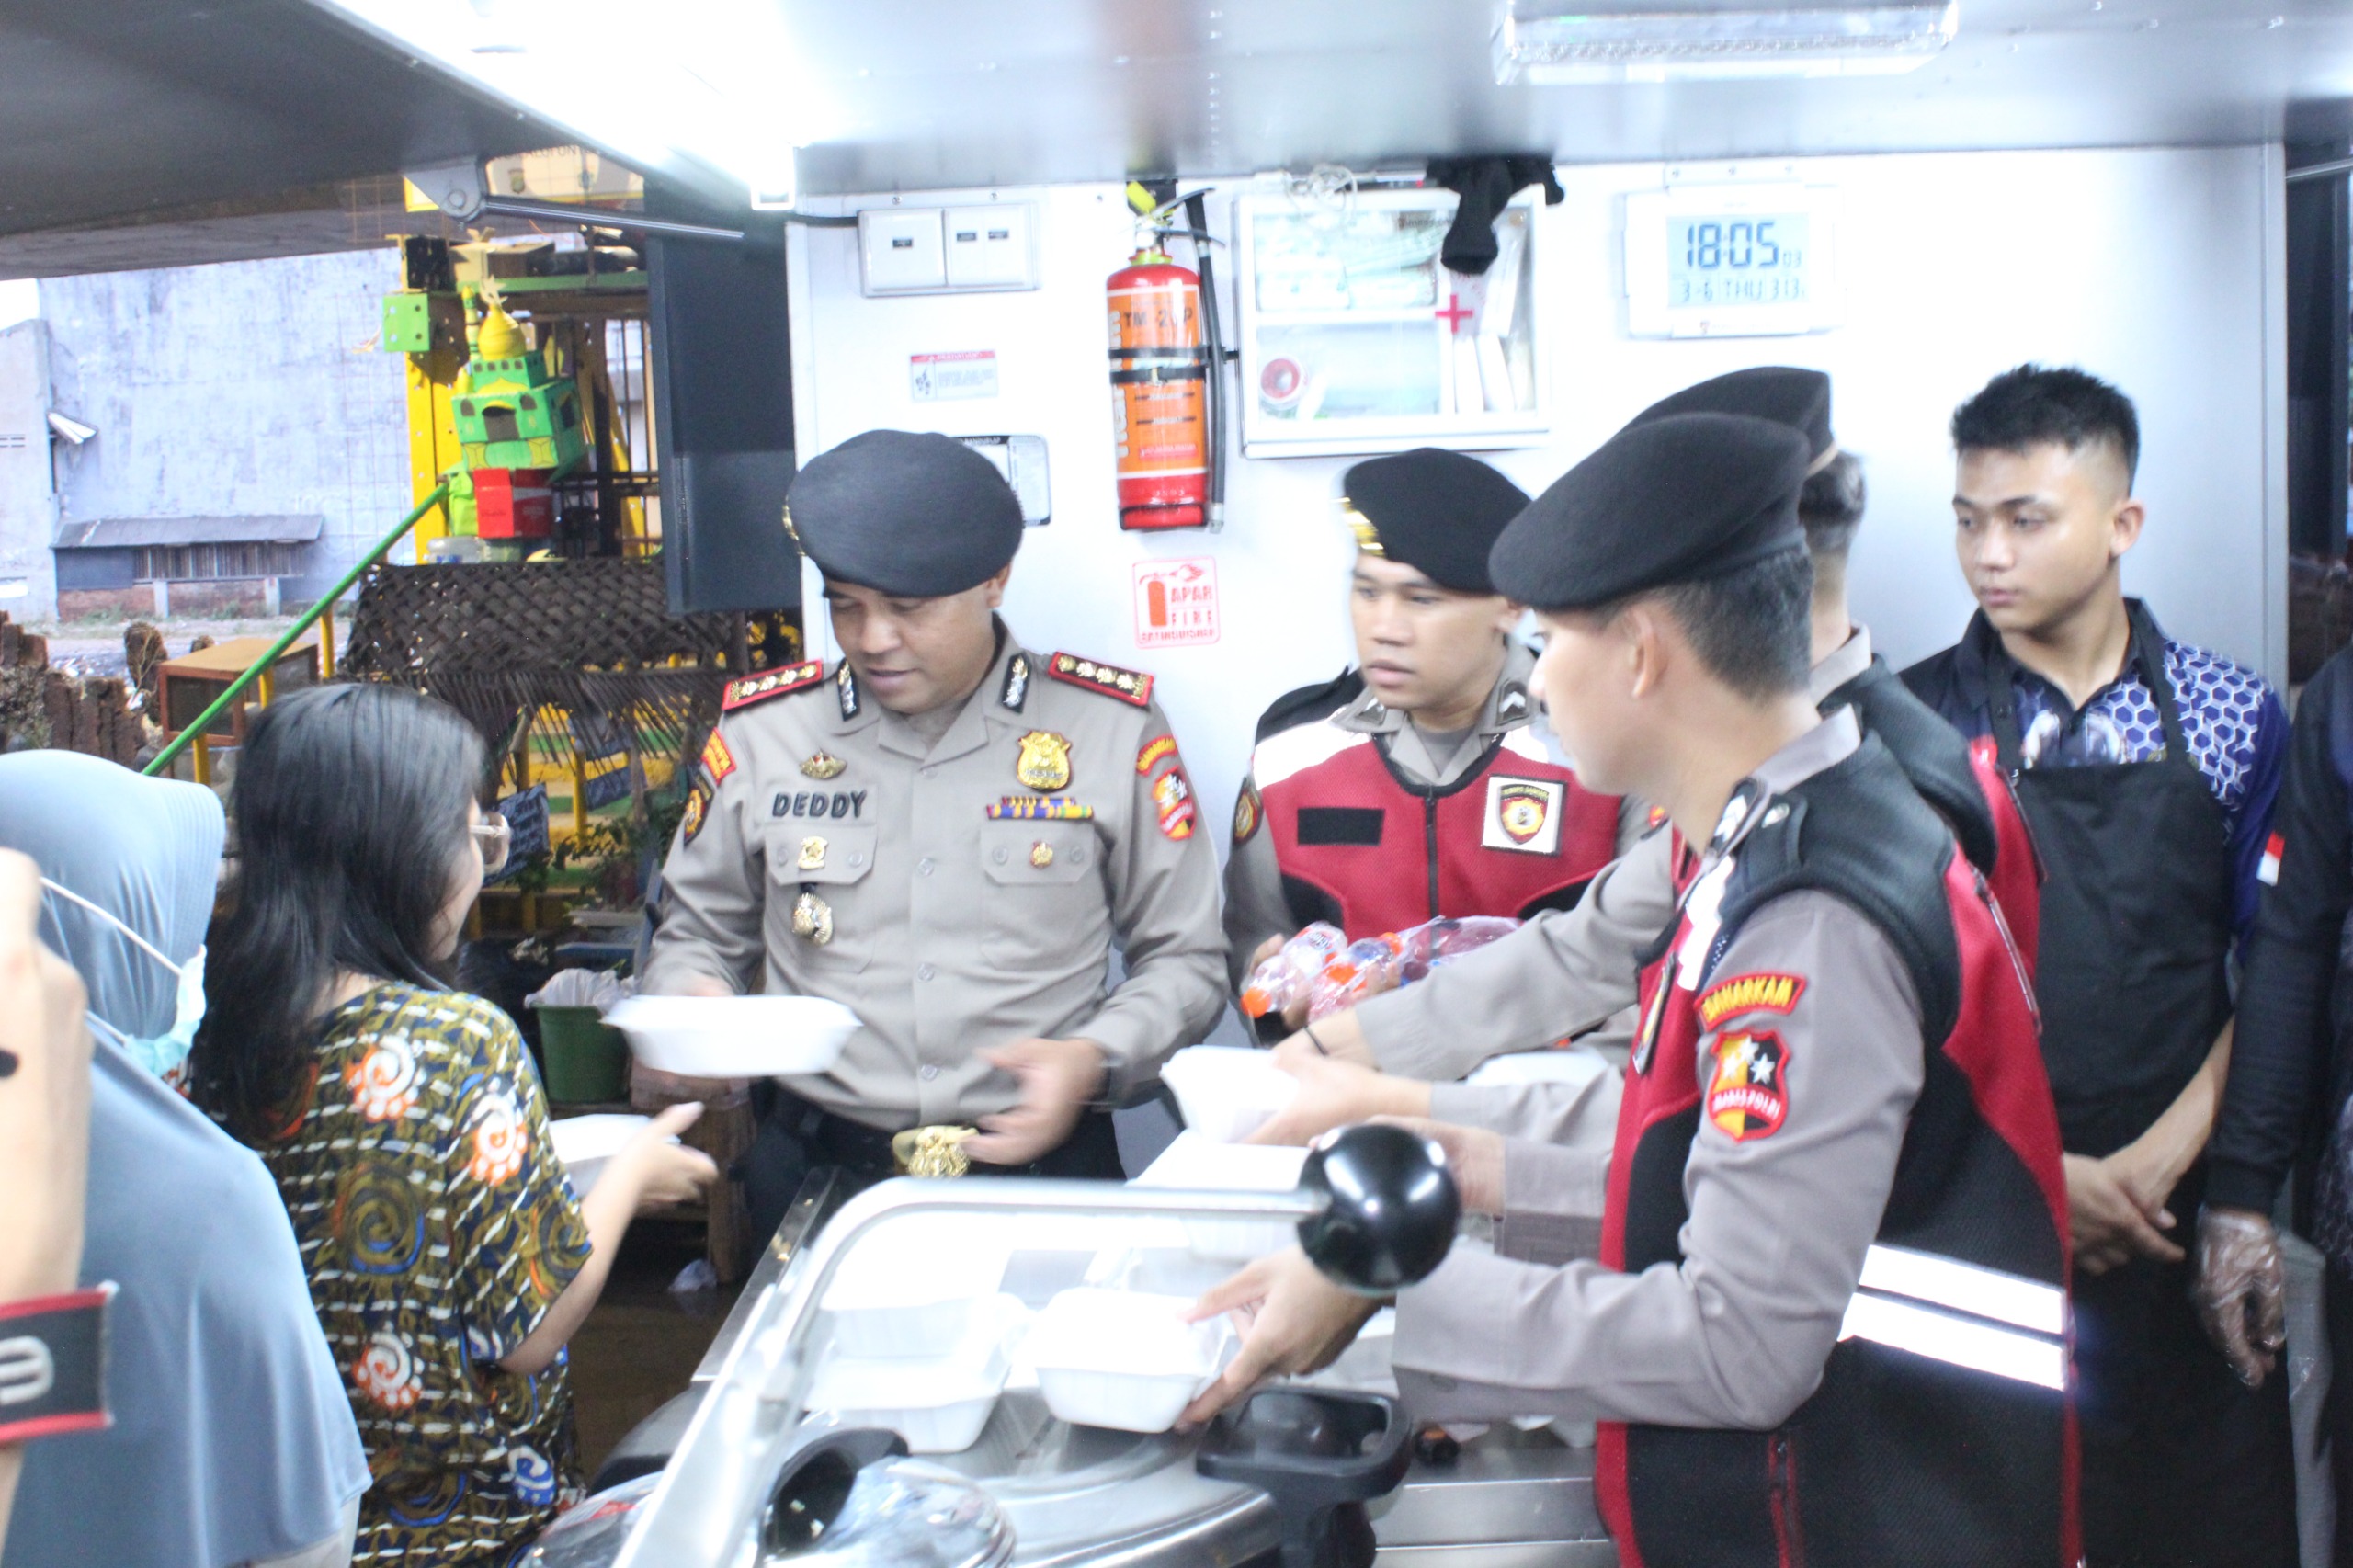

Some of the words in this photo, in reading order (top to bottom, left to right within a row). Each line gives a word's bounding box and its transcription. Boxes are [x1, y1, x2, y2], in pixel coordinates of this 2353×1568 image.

[1687, 222, 1779, 268] 18:05
[1725, 279, 1763, 300] THU
[1171, 585, 1213, 604] APAR
[1172, 610, 1212, 626] FIRE
[772, 789, 868, 818] DEDDY
